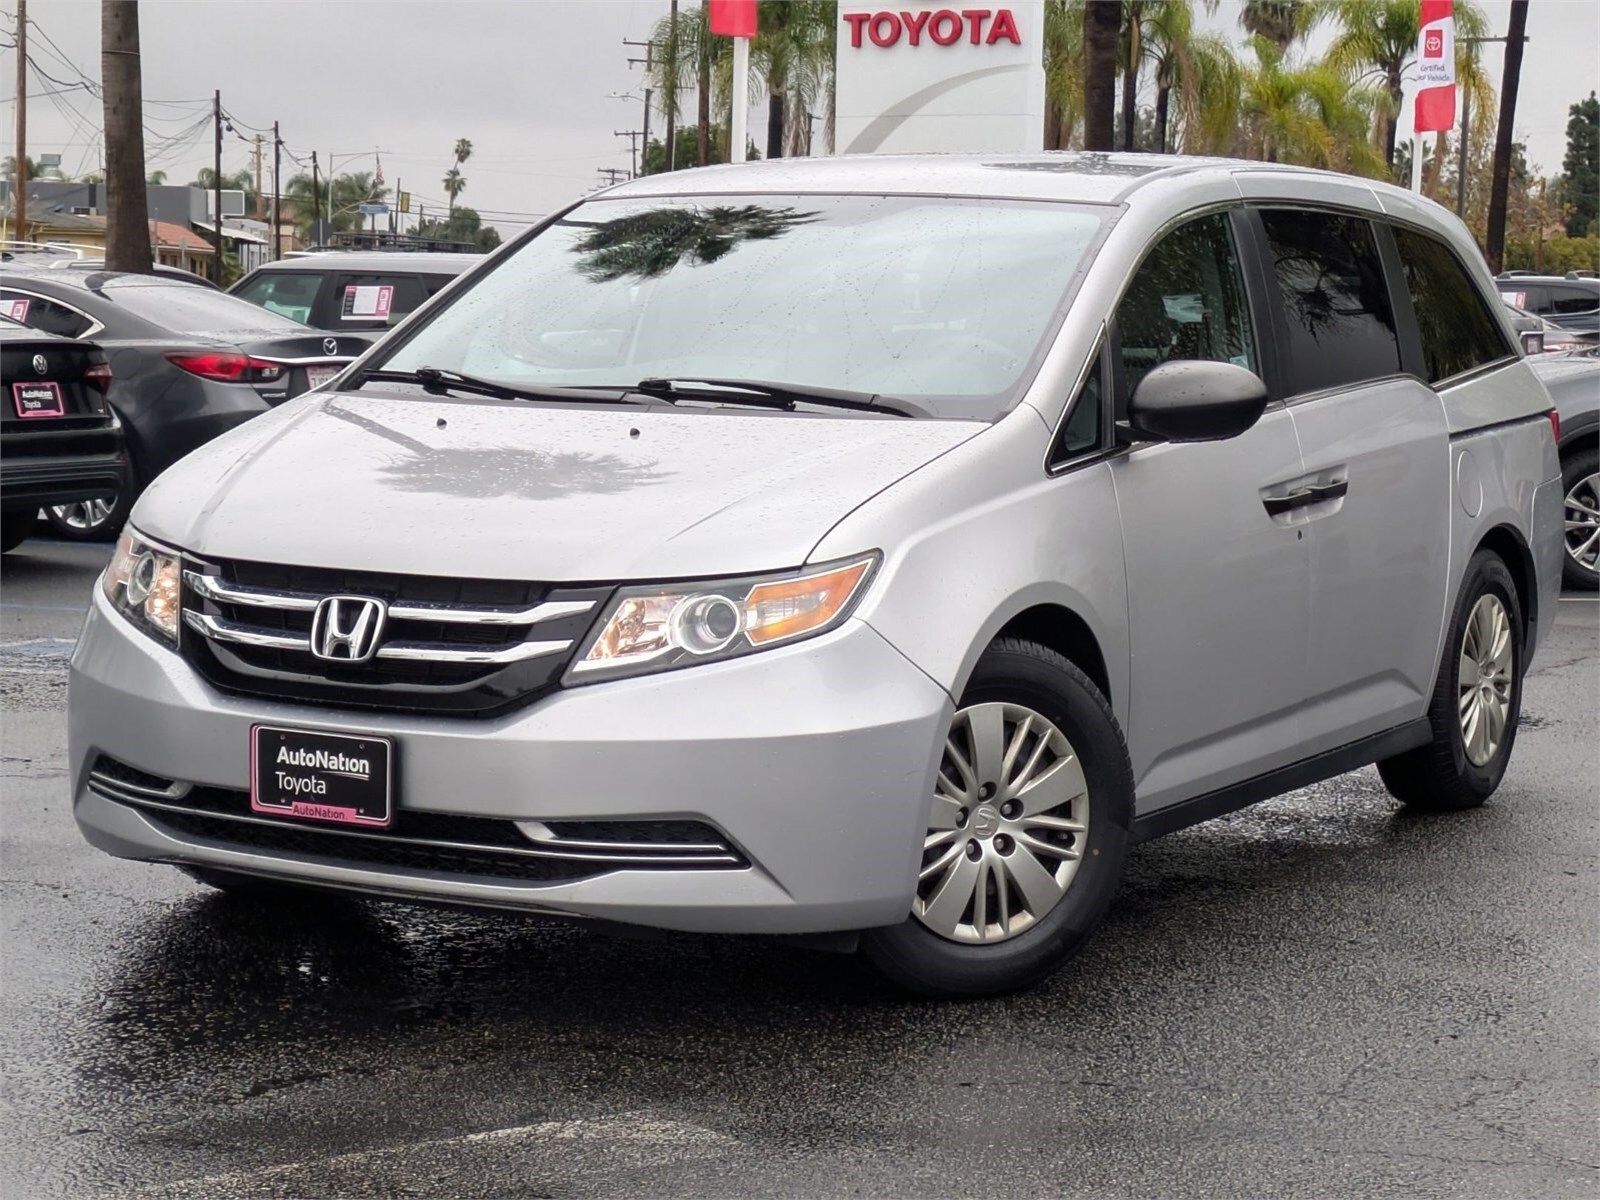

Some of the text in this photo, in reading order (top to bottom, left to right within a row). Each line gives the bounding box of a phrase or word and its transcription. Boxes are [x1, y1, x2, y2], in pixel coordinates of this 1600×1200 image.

[843, 9, 1022, 48] TOYOTA
[276, 746, 370, 774] AutoNation
[275, 771, 327, 795] Toyota
